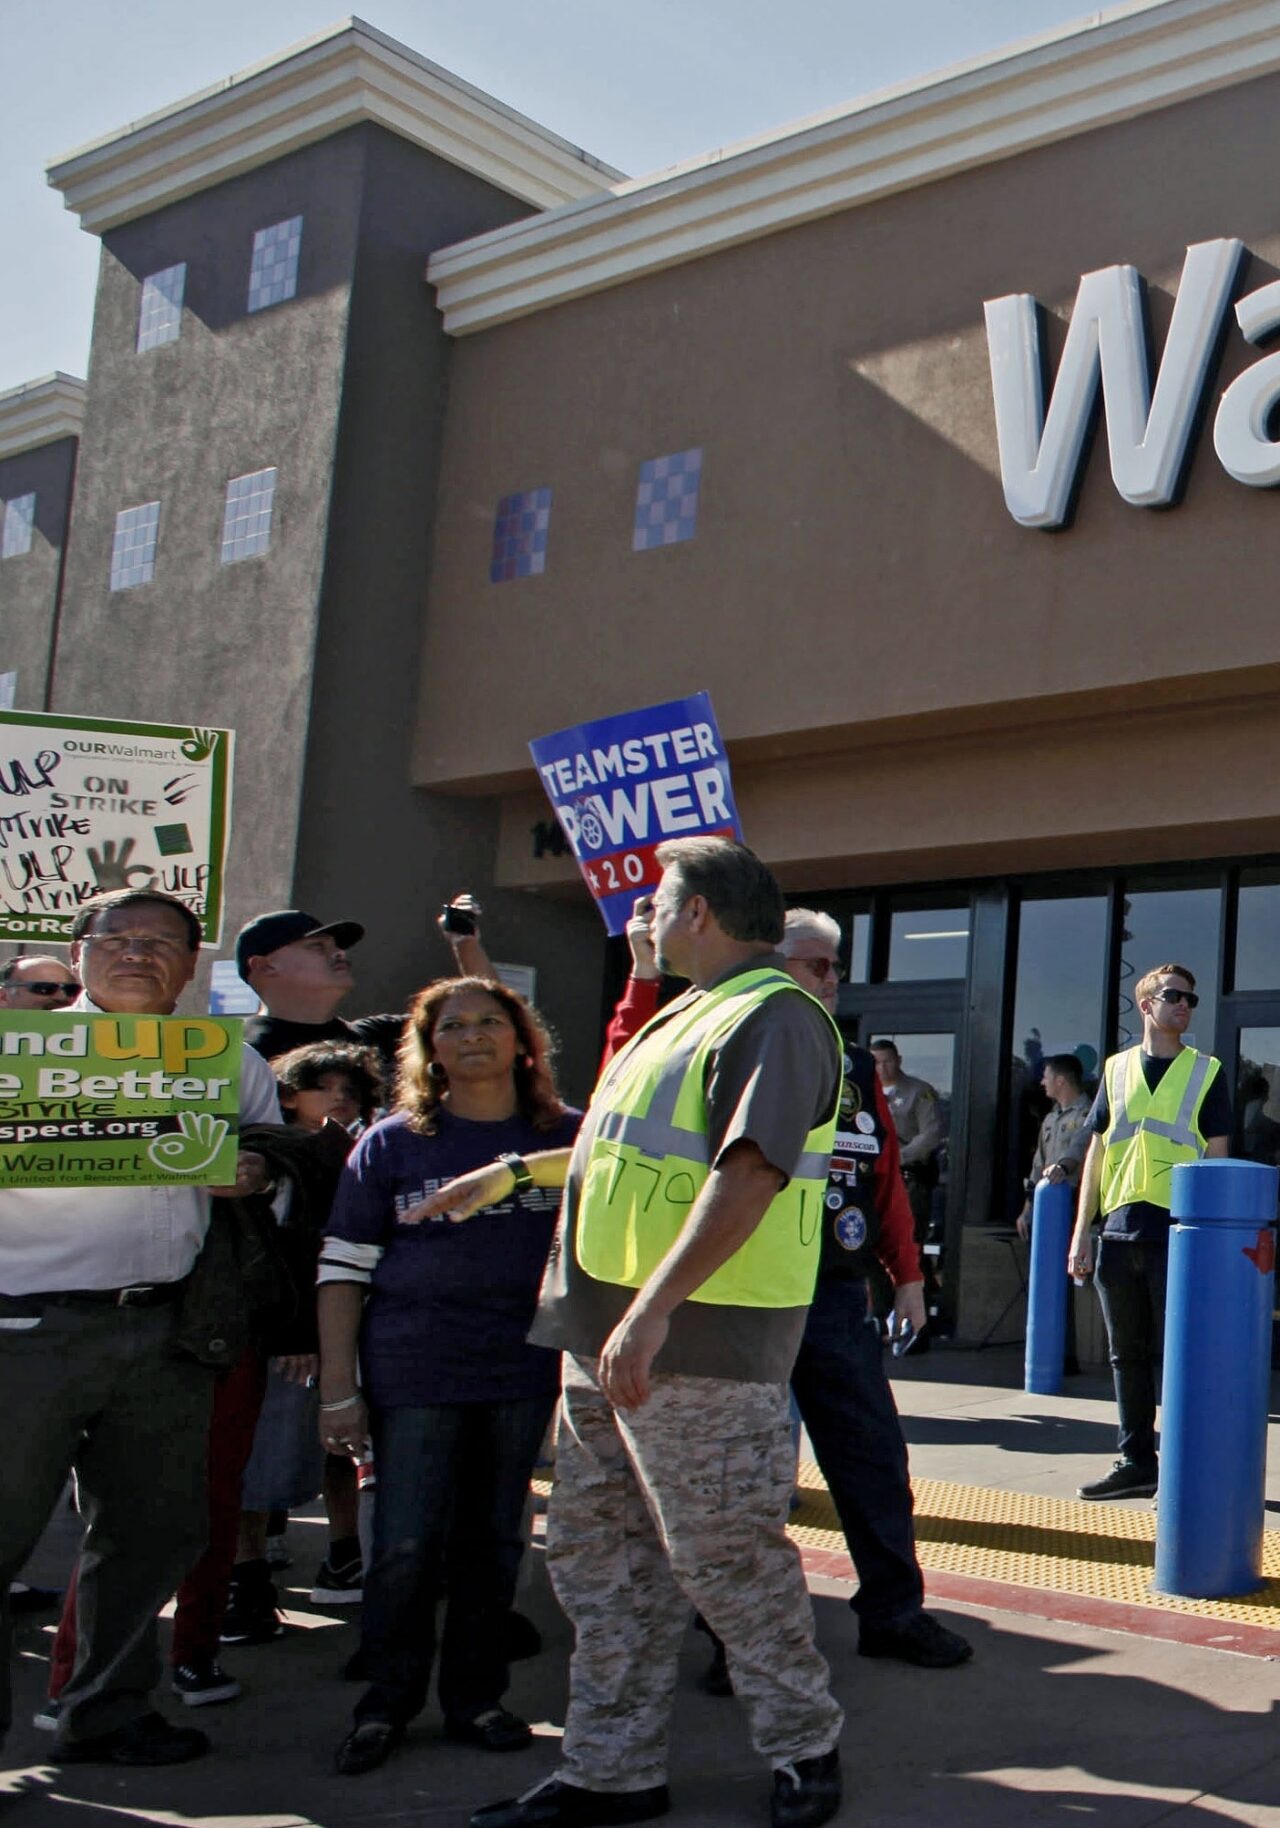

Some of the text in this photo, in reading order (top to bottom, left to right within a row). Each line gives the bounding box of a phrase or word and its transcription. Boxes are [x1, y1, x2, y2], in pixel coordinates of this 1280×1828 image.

[541, 722, 718, 798] TEAMSTER
[83, 776, 130, 795] ON
[50, 793, 158, 816] STRIKE
[1, 845, 74, 890] ULP
[161, 863, 212, 893] ULP
[93, 1019, 228, 1074] up
[38, 1068, 231, 1100] Better
[157, 1173, 207, 1181] Walmart
